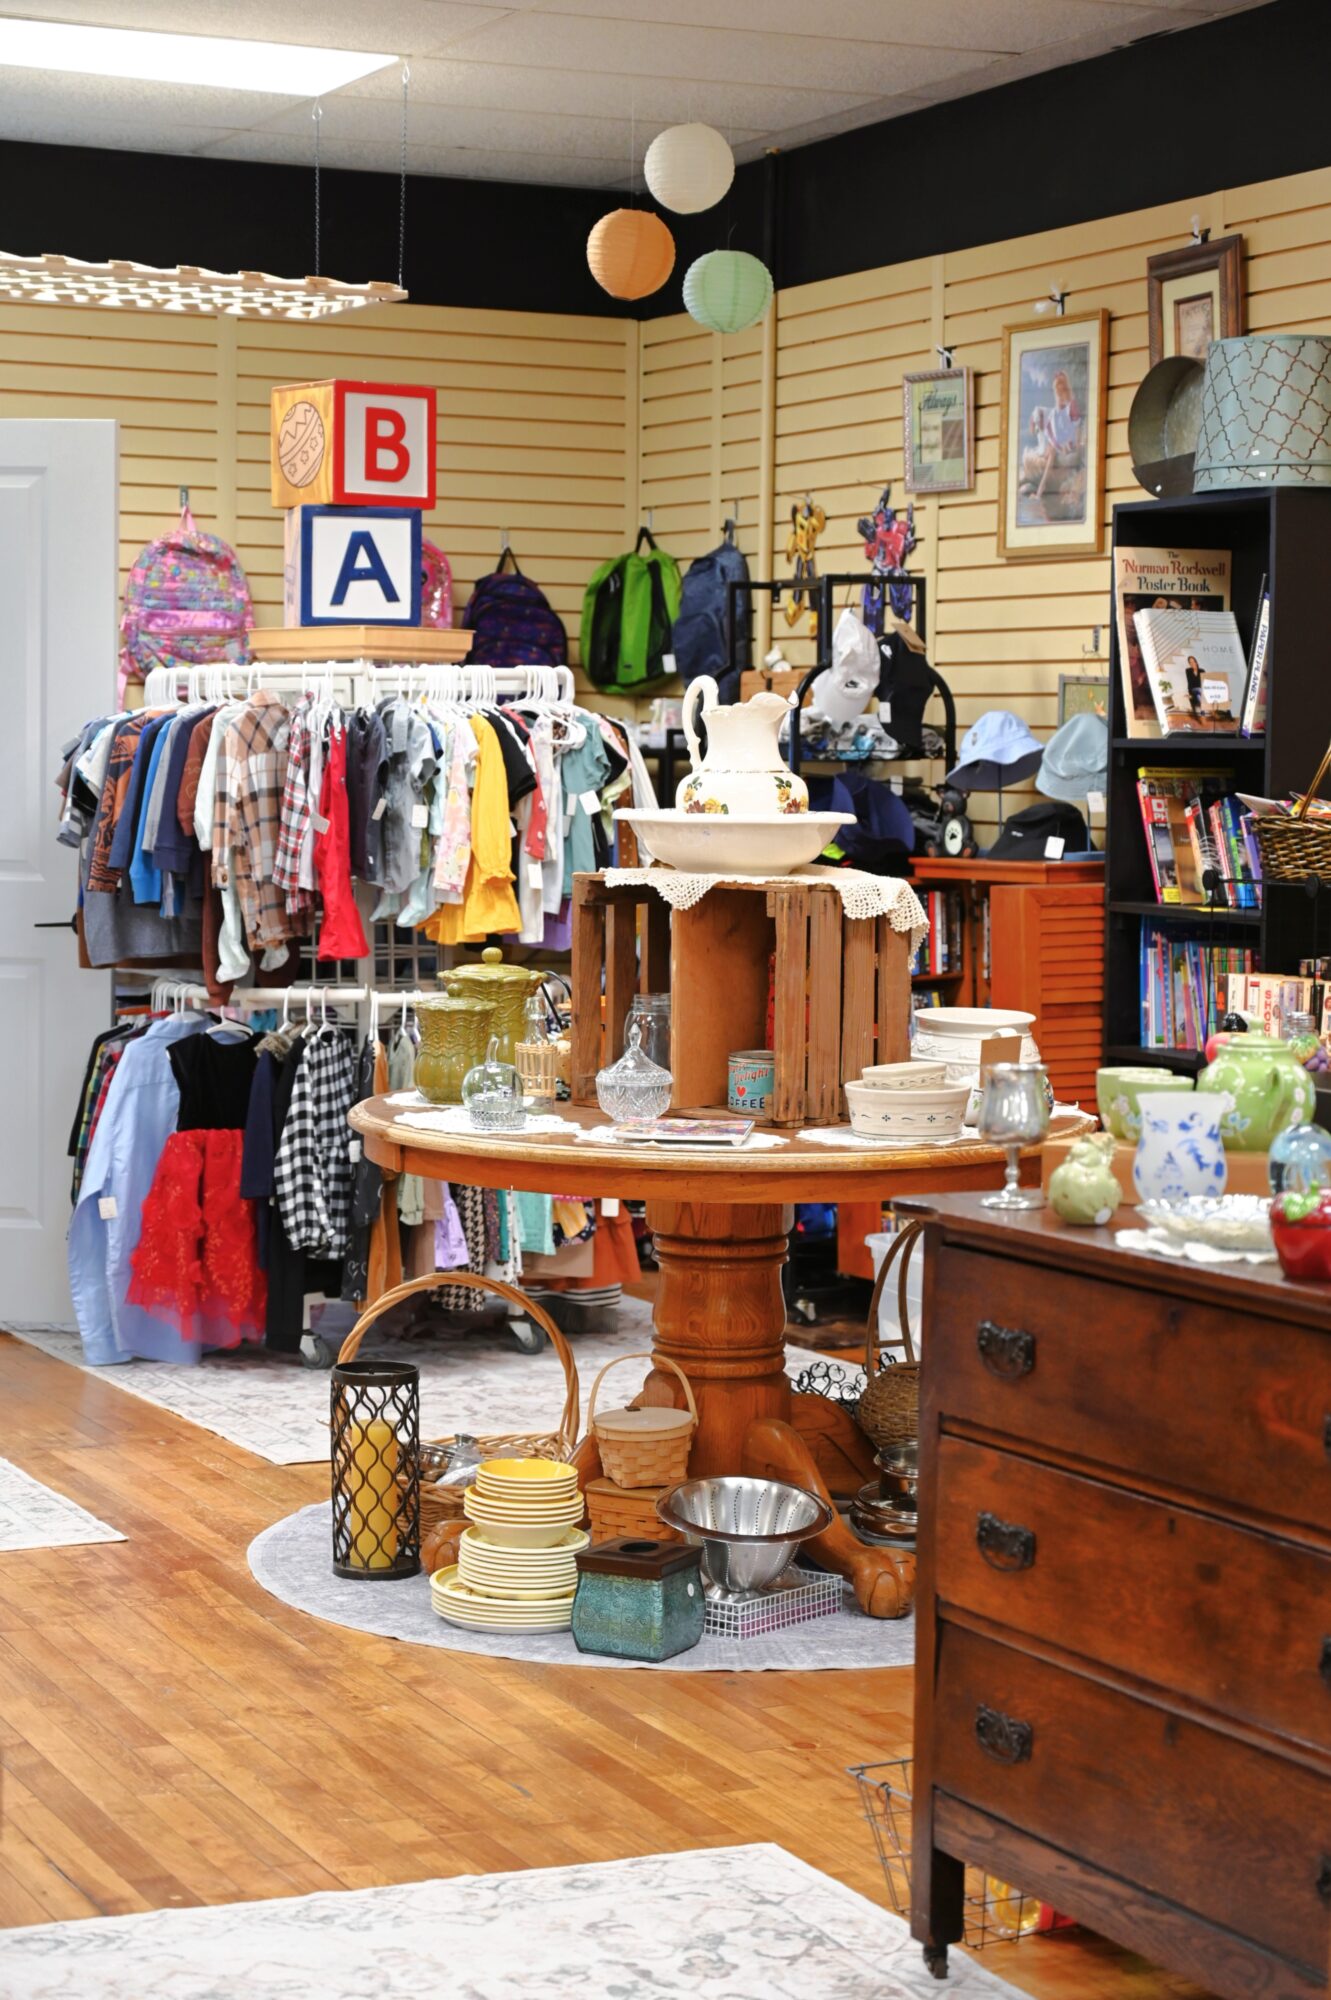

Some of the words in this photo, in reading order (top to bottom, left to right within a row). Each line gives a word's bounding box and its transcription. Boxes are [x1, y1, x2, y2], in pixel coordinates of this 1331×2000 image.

[364, 406, 411, 483] B
[1167, 551, 1180, 559] The
[329, 530, 401, 606] A
[1122, 559, 1169, 575] Norman
[1170, 560, 1226, 577] Rockwell
[1136, 576, 1177, 591] Poster
[1177, 576, 1211, 592] Book
[1202, 645, 1236, 654] HOME
[1256, 624, 1268, 660] PAPER
[1249, 660, 1263, 702] PLANES
[729, 1096, 765, 1109] OFFEE
